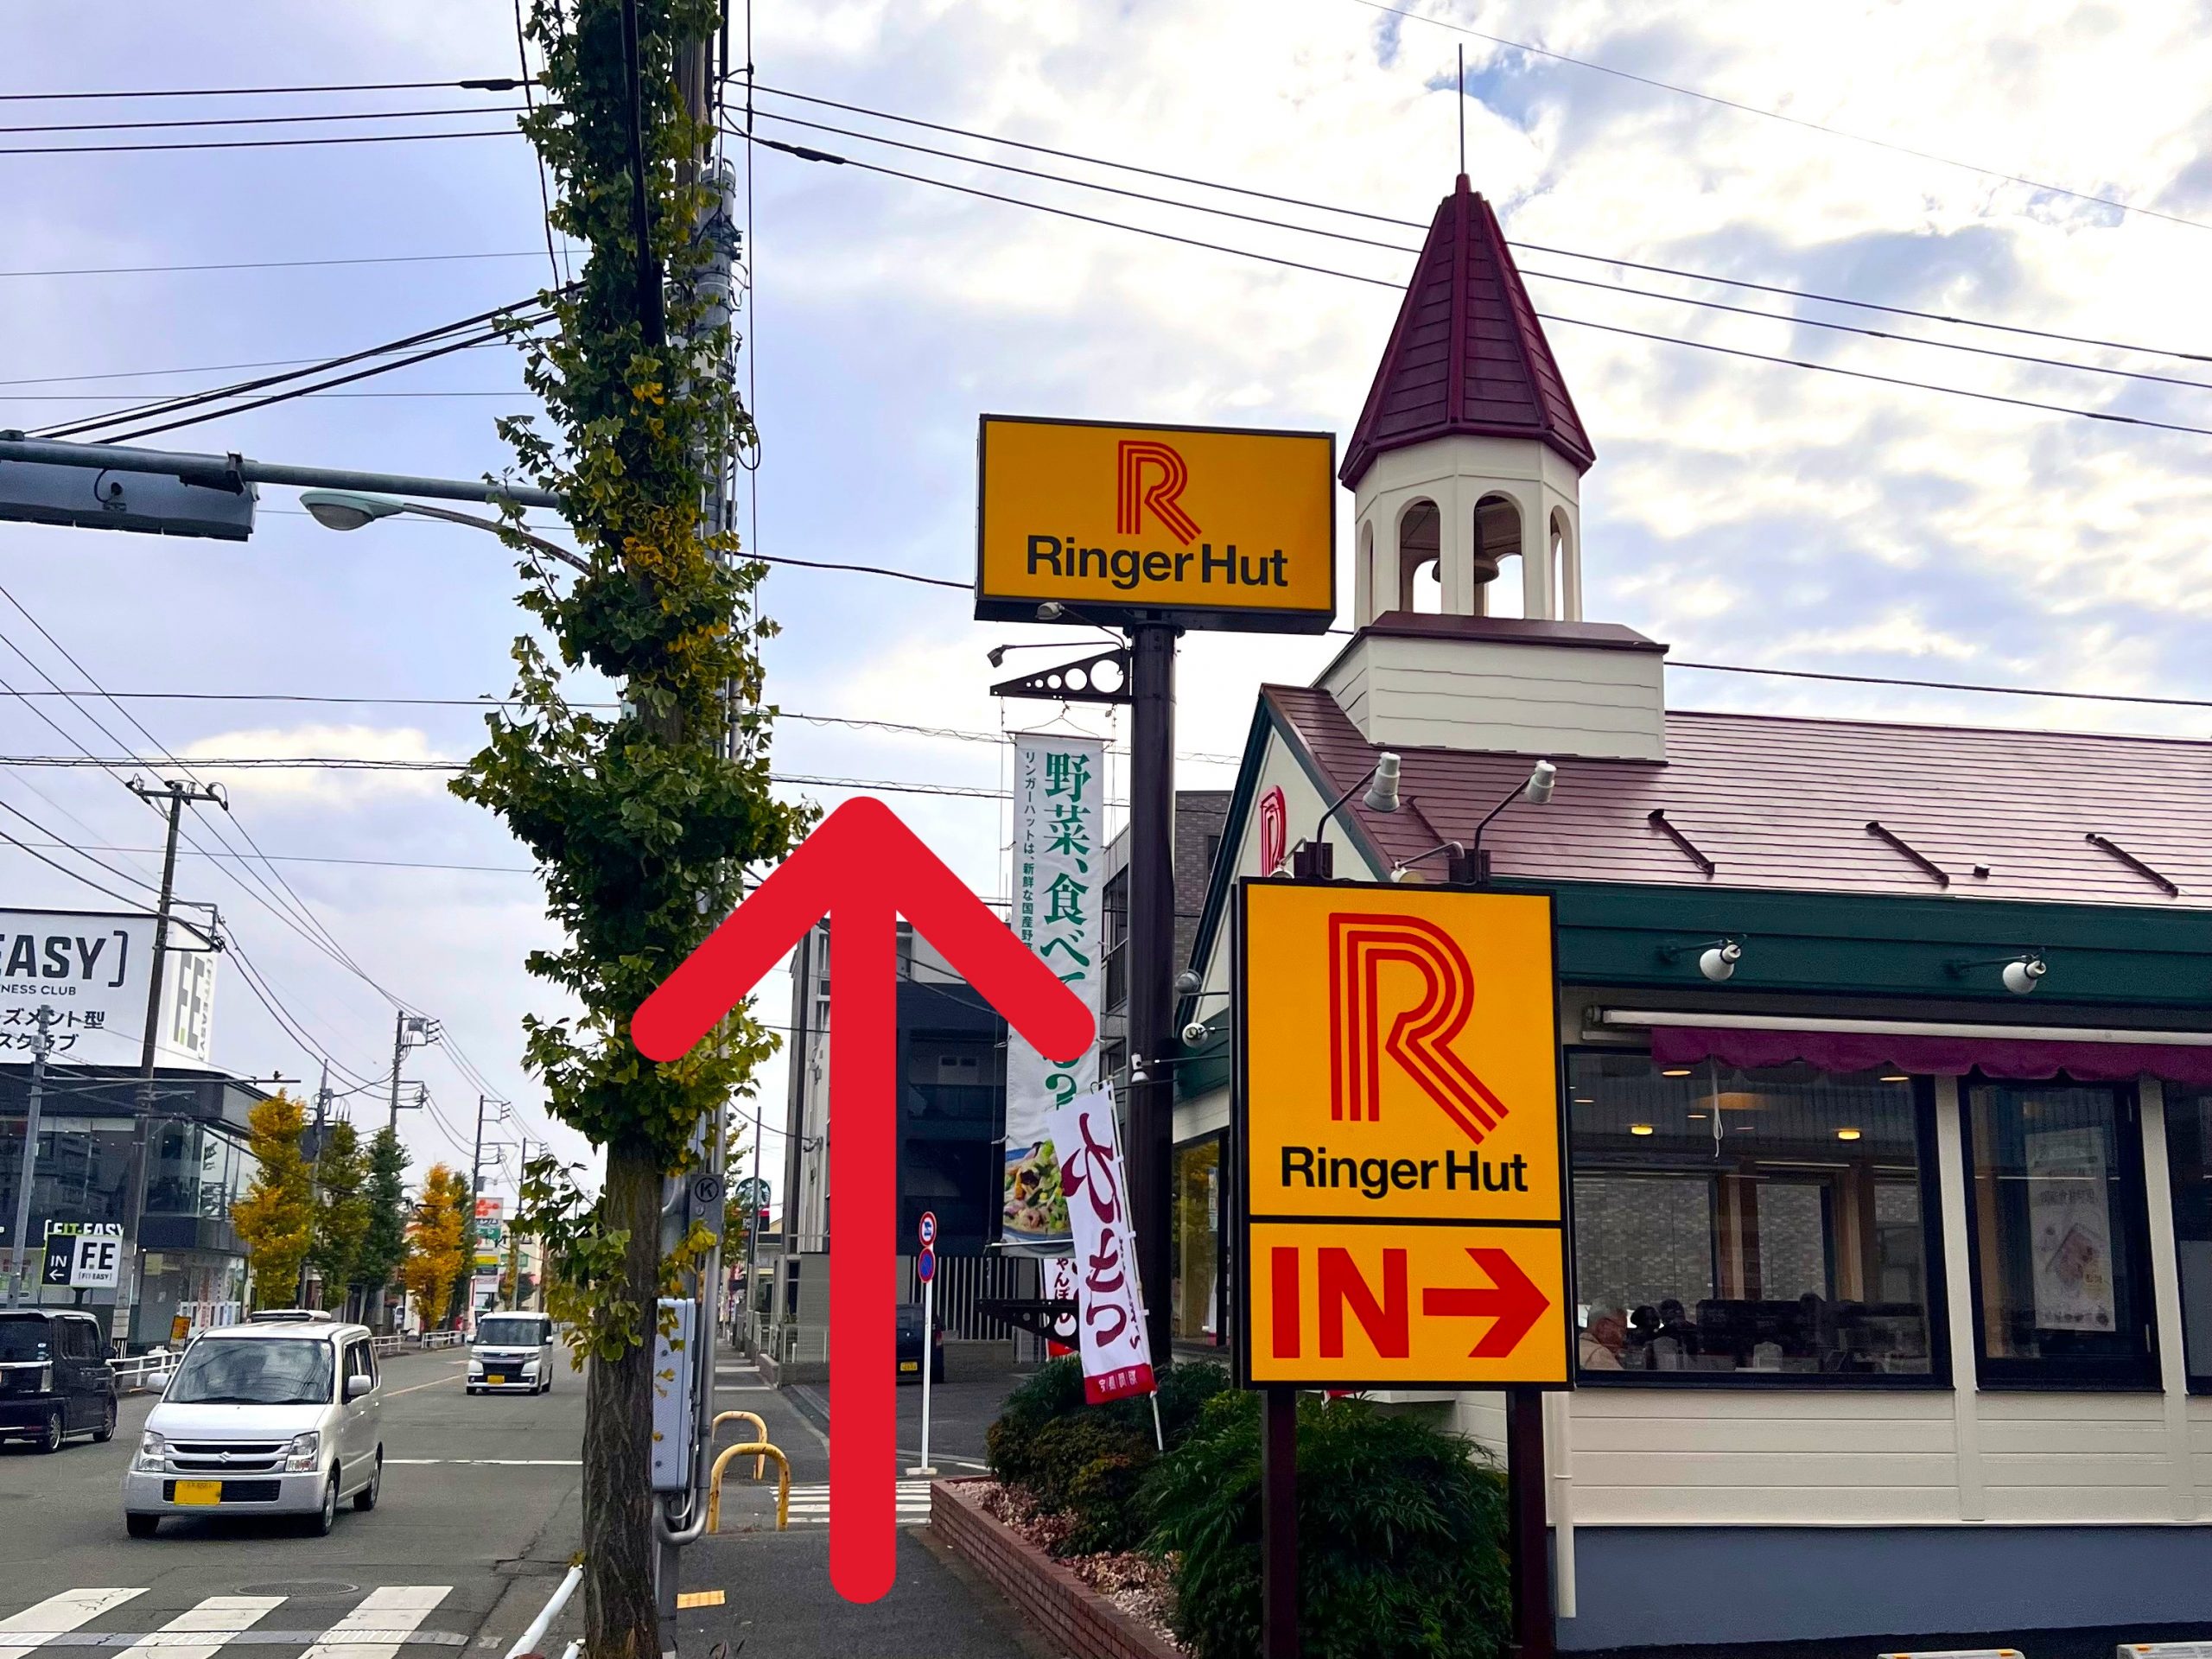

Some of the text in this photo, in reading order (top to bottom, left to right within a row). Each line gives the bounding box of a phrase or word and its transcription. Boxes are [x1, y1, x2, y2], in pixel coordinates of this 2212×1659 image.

[1117, 440, 1202, 546] R
[1027, 534, 1288, 589] Ringer Hut
[41, 985, 76, 995] CLUB
[1328, 912, 1510, 1145] R
[1281, 1146, 1529, 1199] Ringer Hut
[50, 1255, 67, 1268] IN
[1271, 1246, 1410, 1359] IN
